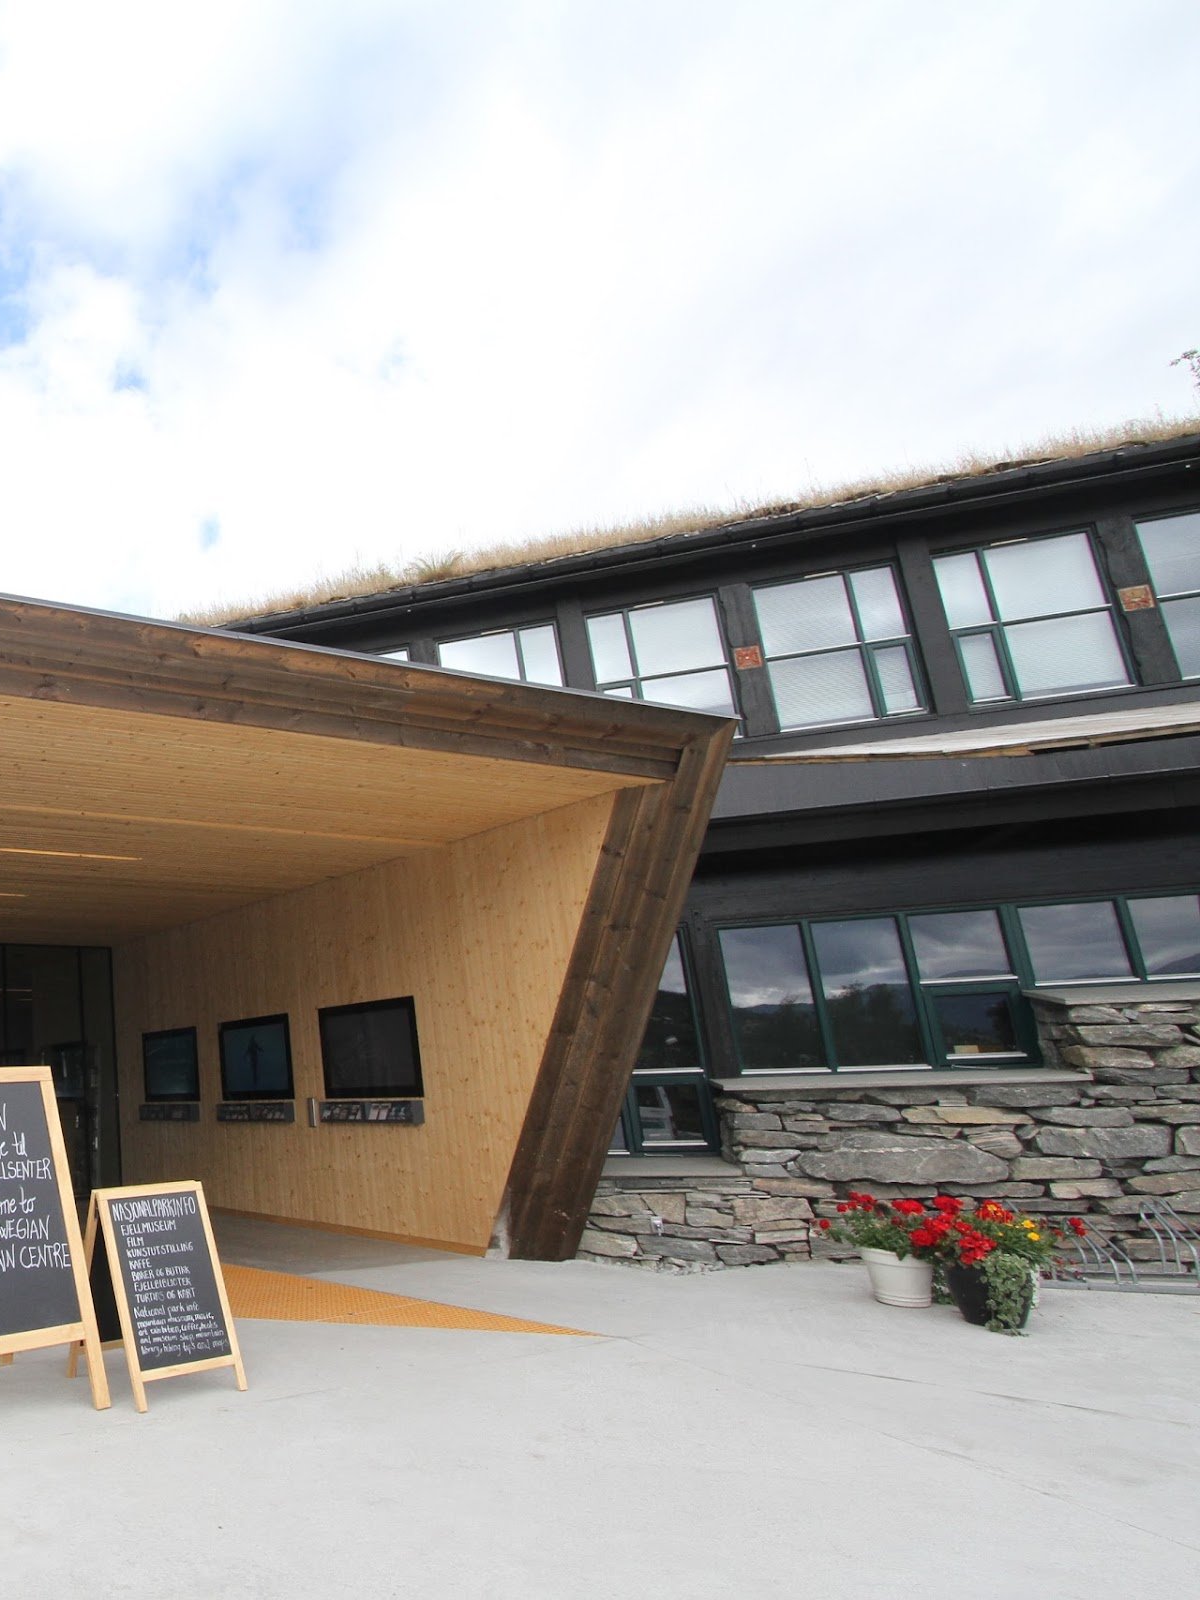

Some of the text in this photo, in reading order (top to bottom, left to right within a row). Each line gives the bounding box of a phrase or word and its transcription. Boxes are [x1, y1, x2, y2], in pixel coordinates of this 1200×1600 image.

[12, 1131, 28, 1157] til
[19, 1186, 36, 1214] to
[111, 1196, 196, 1222] NASJONALPARKINFO
[120, 1219, 177, 1236] FJELLMUSEUM
[125, 1241, 194, 1258] KUNSTUTSTILLING
[126, 1236, 145, 1248] FILM
[19, 1242, 71, 1269] CENTRE
[128, 1258, 152, 1270] KAFFE
[155, 1268, 165, 1277] OG
[166, 1289, 176, 1300] OG
